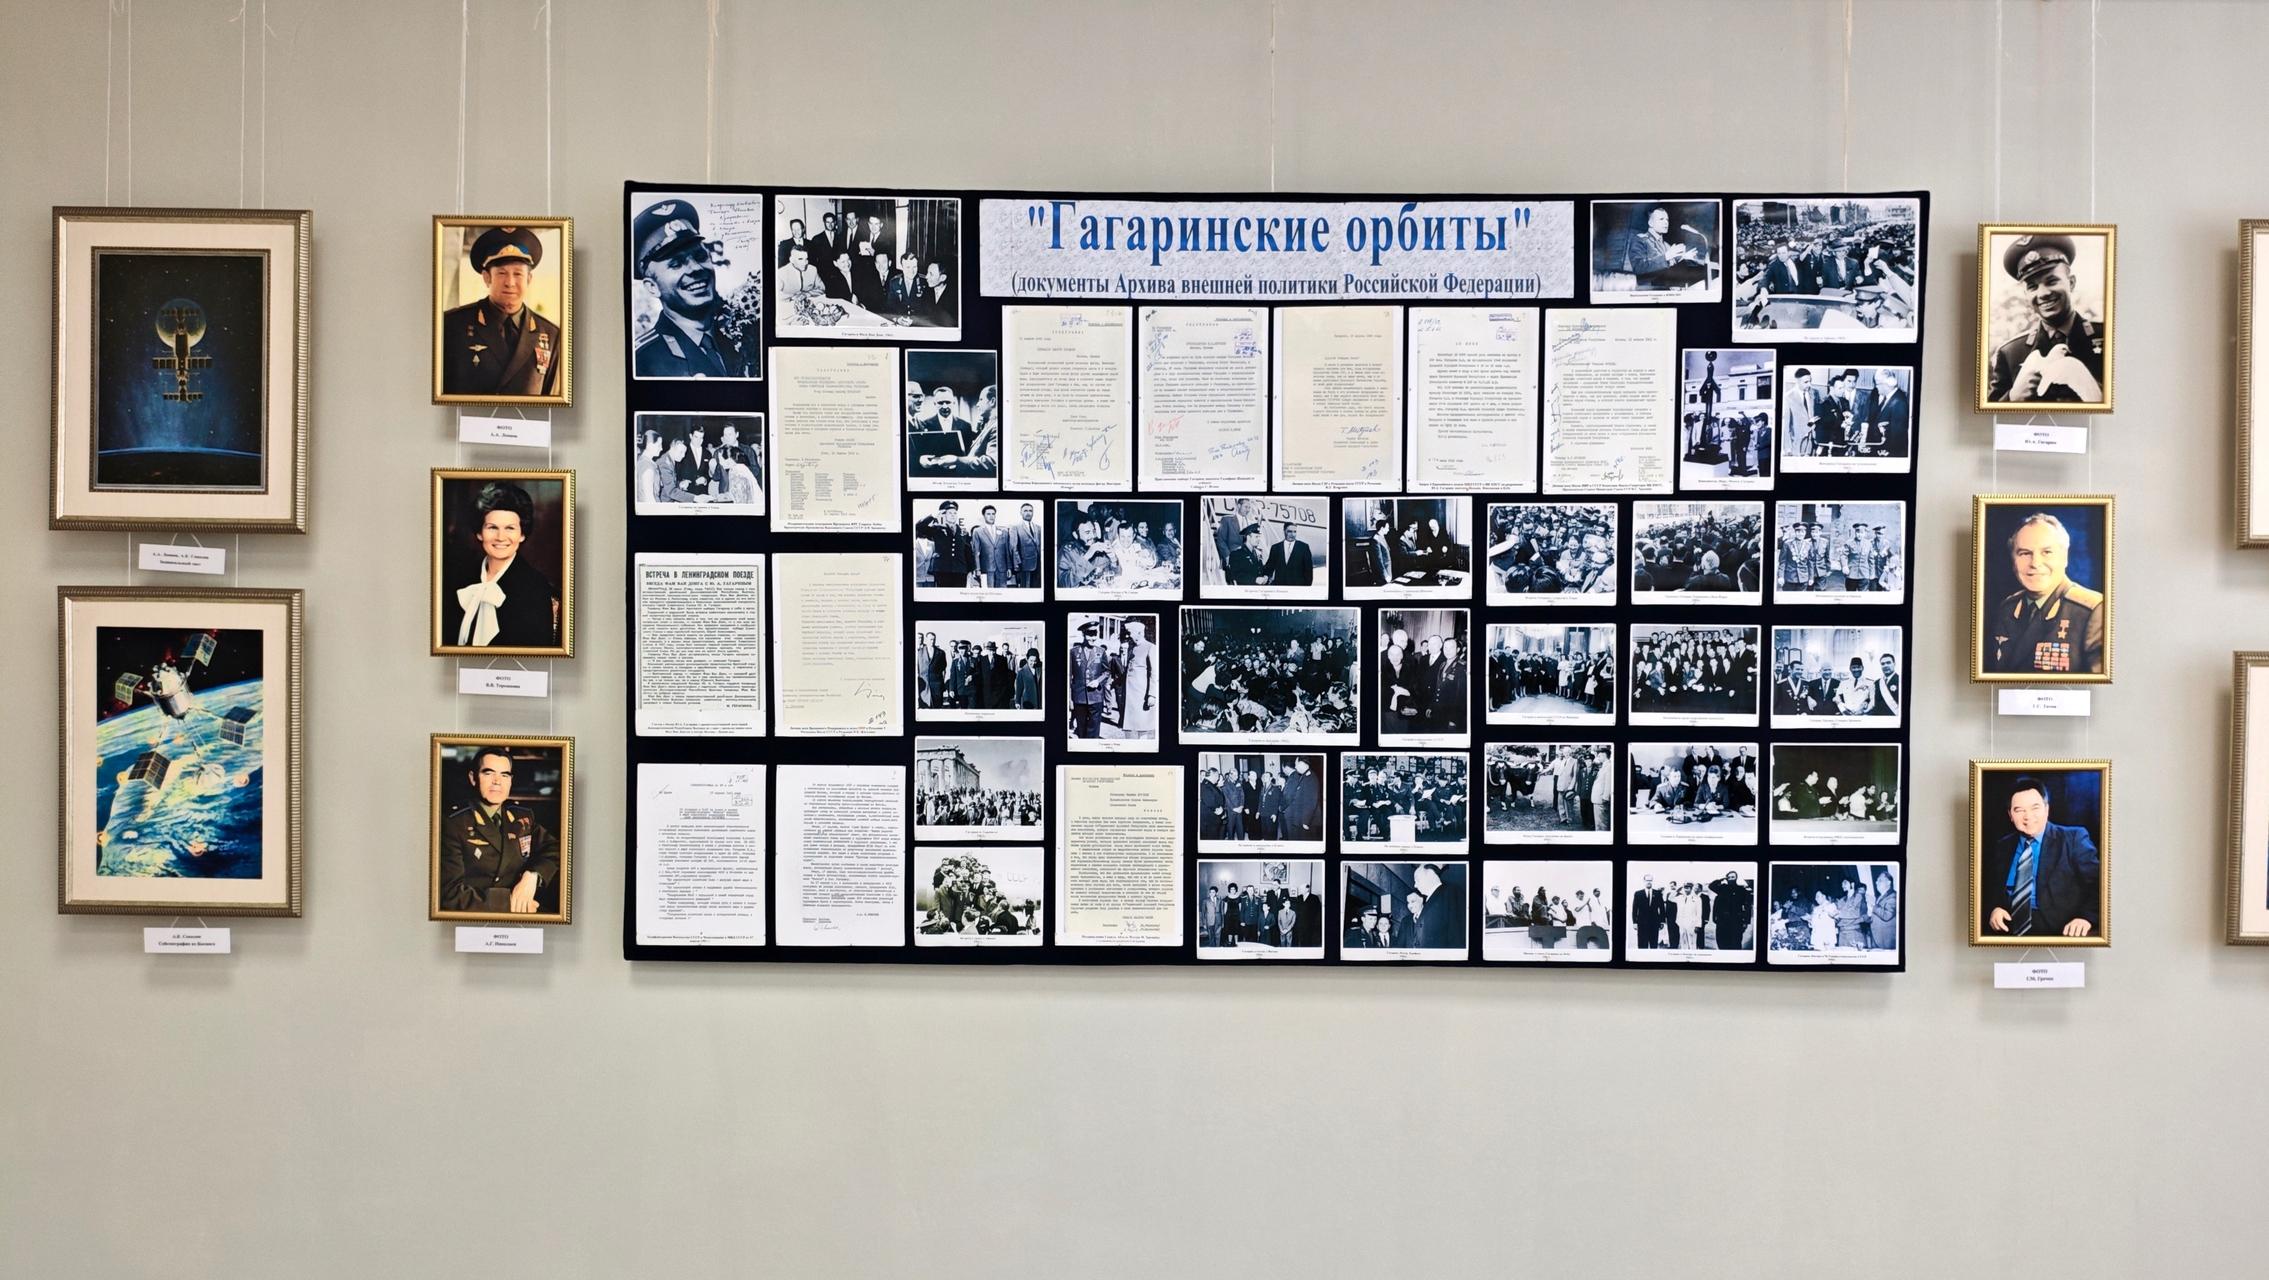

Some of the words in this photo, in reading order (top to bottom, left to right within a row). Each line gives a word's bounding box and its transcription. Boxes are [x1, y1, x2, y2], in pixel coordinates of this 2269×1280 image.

[1028, 202, 1330, 266] "Гагаринские
[1345, 203, 1531, 267] орбиты"
[1011, 271, 1110, 296] (документы
[1114, 273, 1176, 297] Архива
[1181, 274, 1253, 294] внешней
[1258, 279, 1338, 294] политики
[1343, 273, 1439, 294] Российской
[1443, 272, 1542, 298] Федерации)
[646, 571, 670, 579] ВСТРЕЧА
[682, 571, 729, 580] ЛЕНИНГРАДСКОМ
[733, 571, 754, 580] ПОЕЗДЕ
